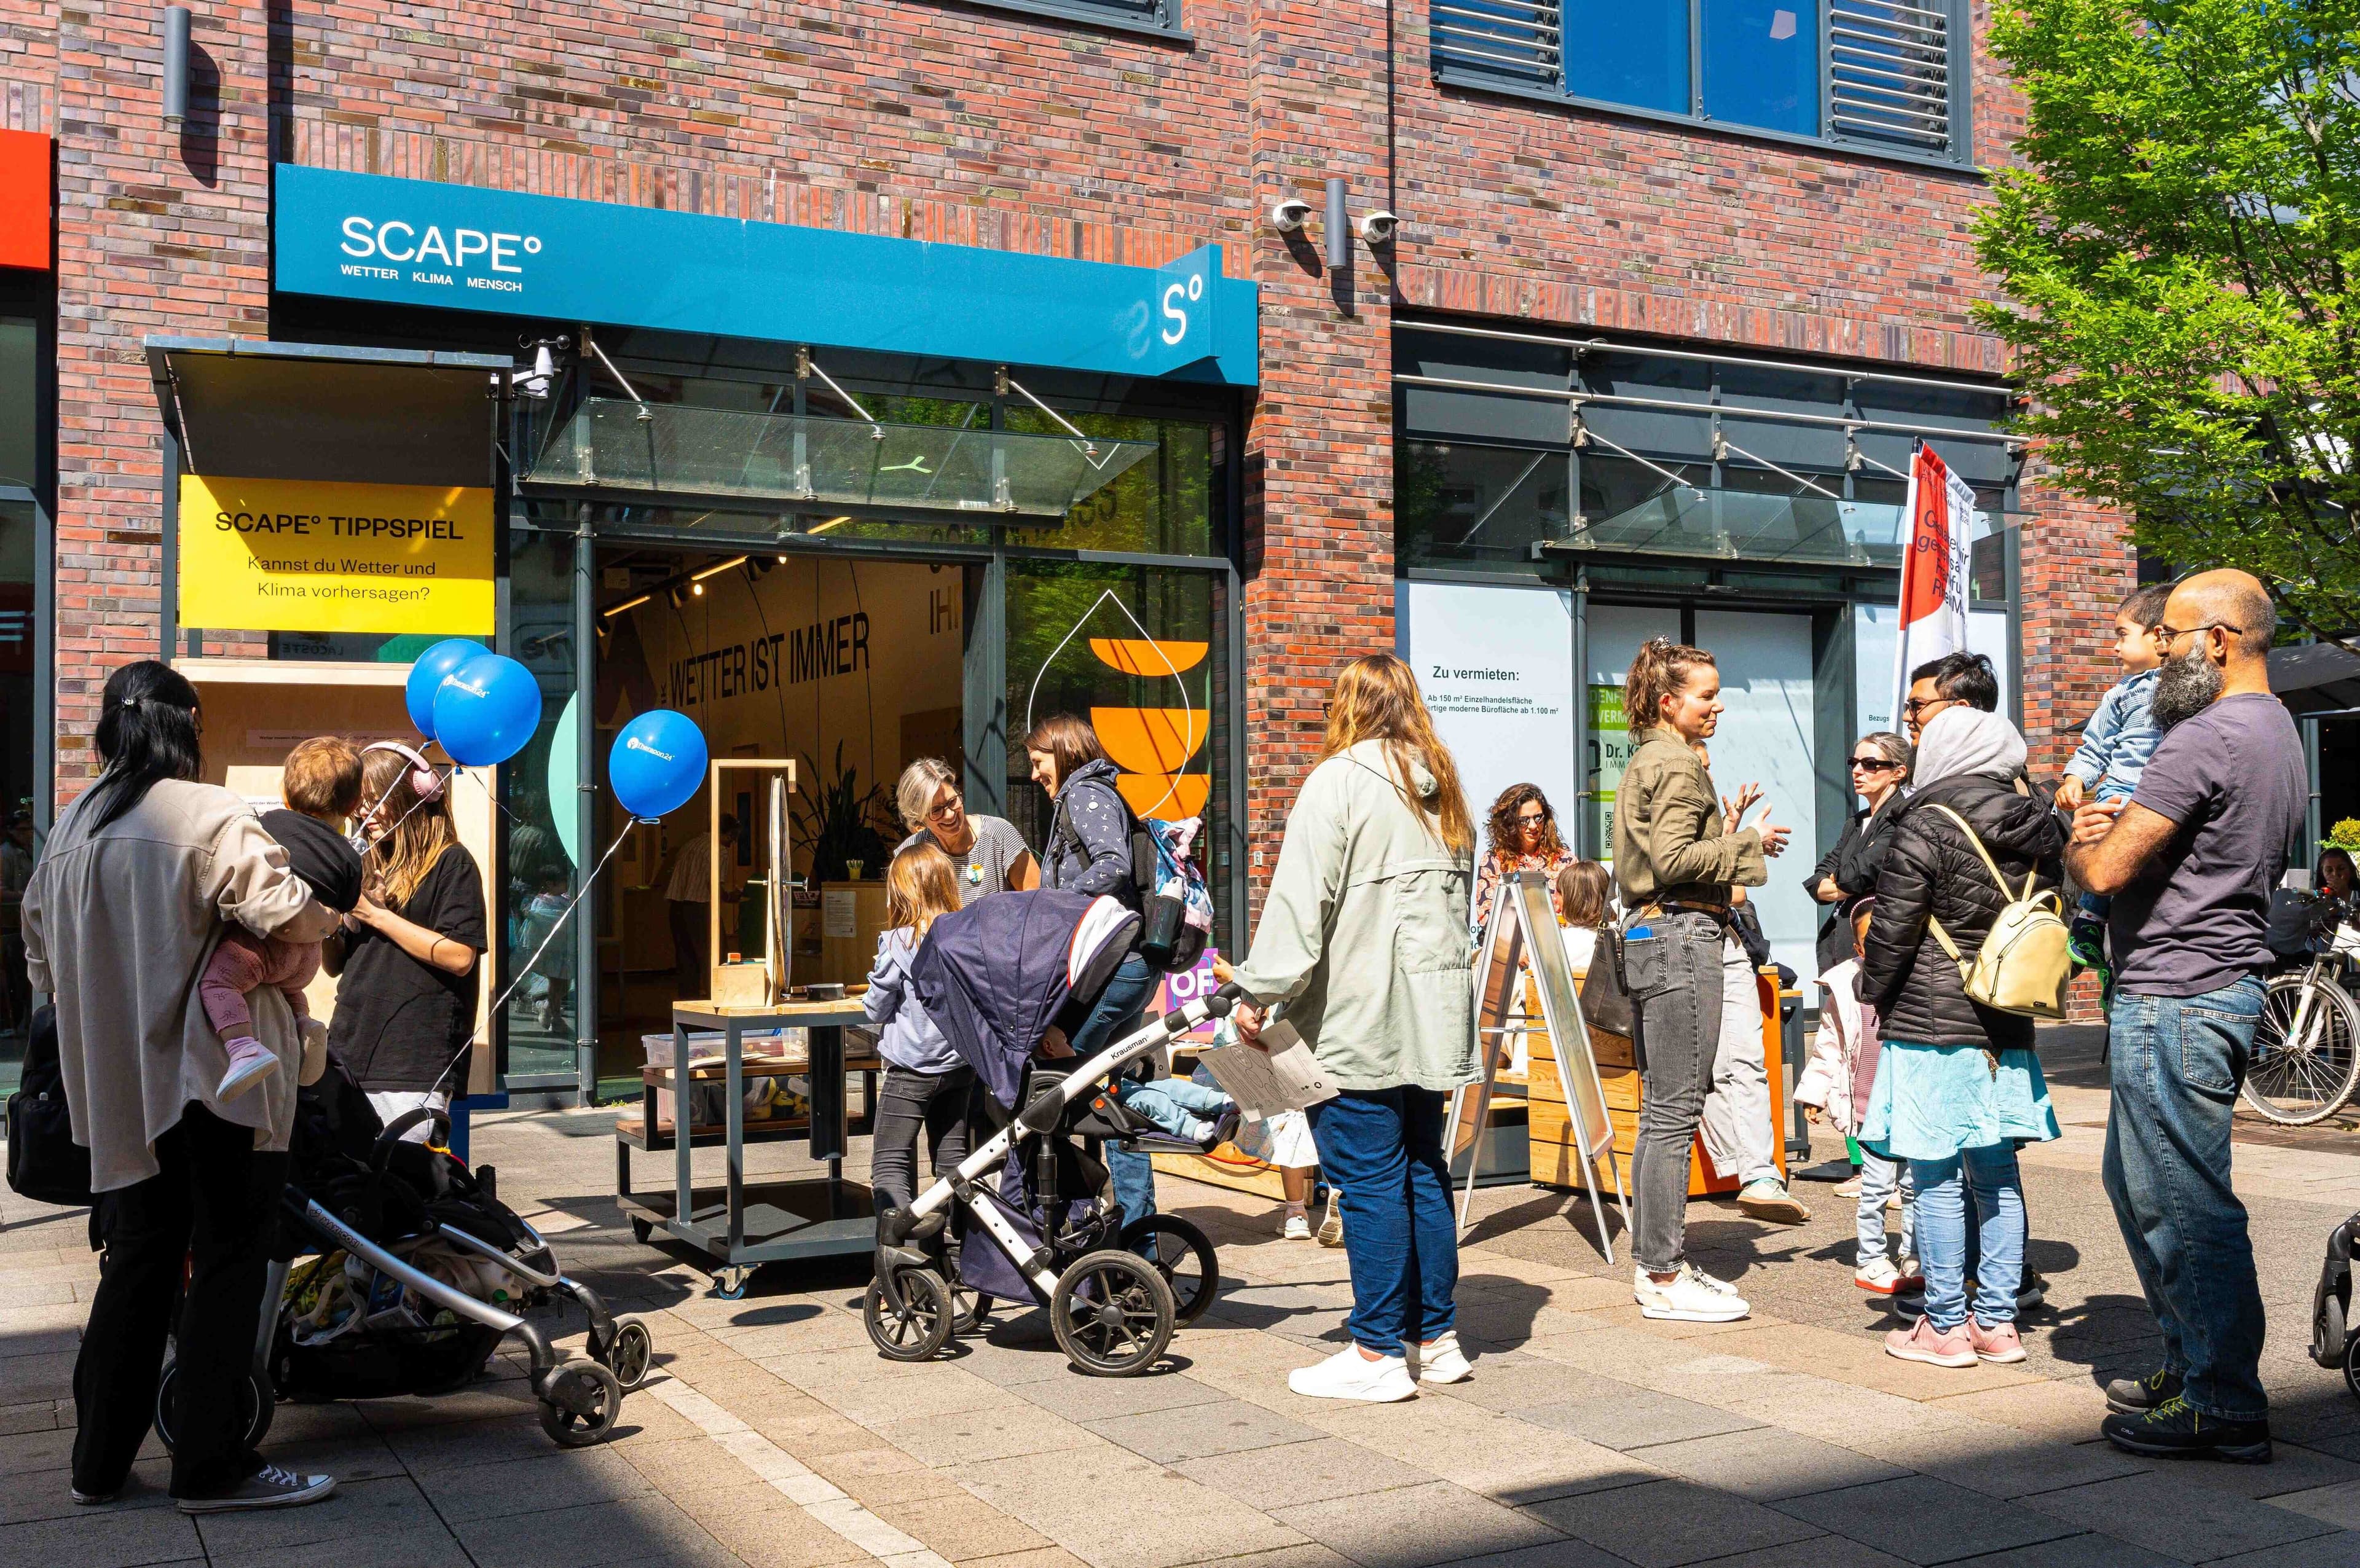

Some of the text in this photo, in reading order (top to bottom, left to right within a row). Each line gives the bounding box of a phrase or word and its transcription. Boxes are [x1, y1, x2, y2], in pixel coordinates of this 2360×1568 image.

[340, 216, 541, 273] SCAPE°
[340, 264, 522, 292] WETTER KLIMA MENSCH
[215, 512, 464, 540] SCAPE° TIPPSPIEL
[248, 556, 436, 575] Kannst du Wetter und
[258, 582, 430, 602] Klima vorhersagen?
[670, 612, 870, 708] WETTER IST IMMER
[1433, 665, 1520, 681] Zu vermieten:
[1426, 704, 1447, 713] ertige
[1464, 696, 1533, 705] Einzelhandelsfläche
[1599, 710, 1627, 724] VERM
[1605, 743, 1622, 758] Dr.
